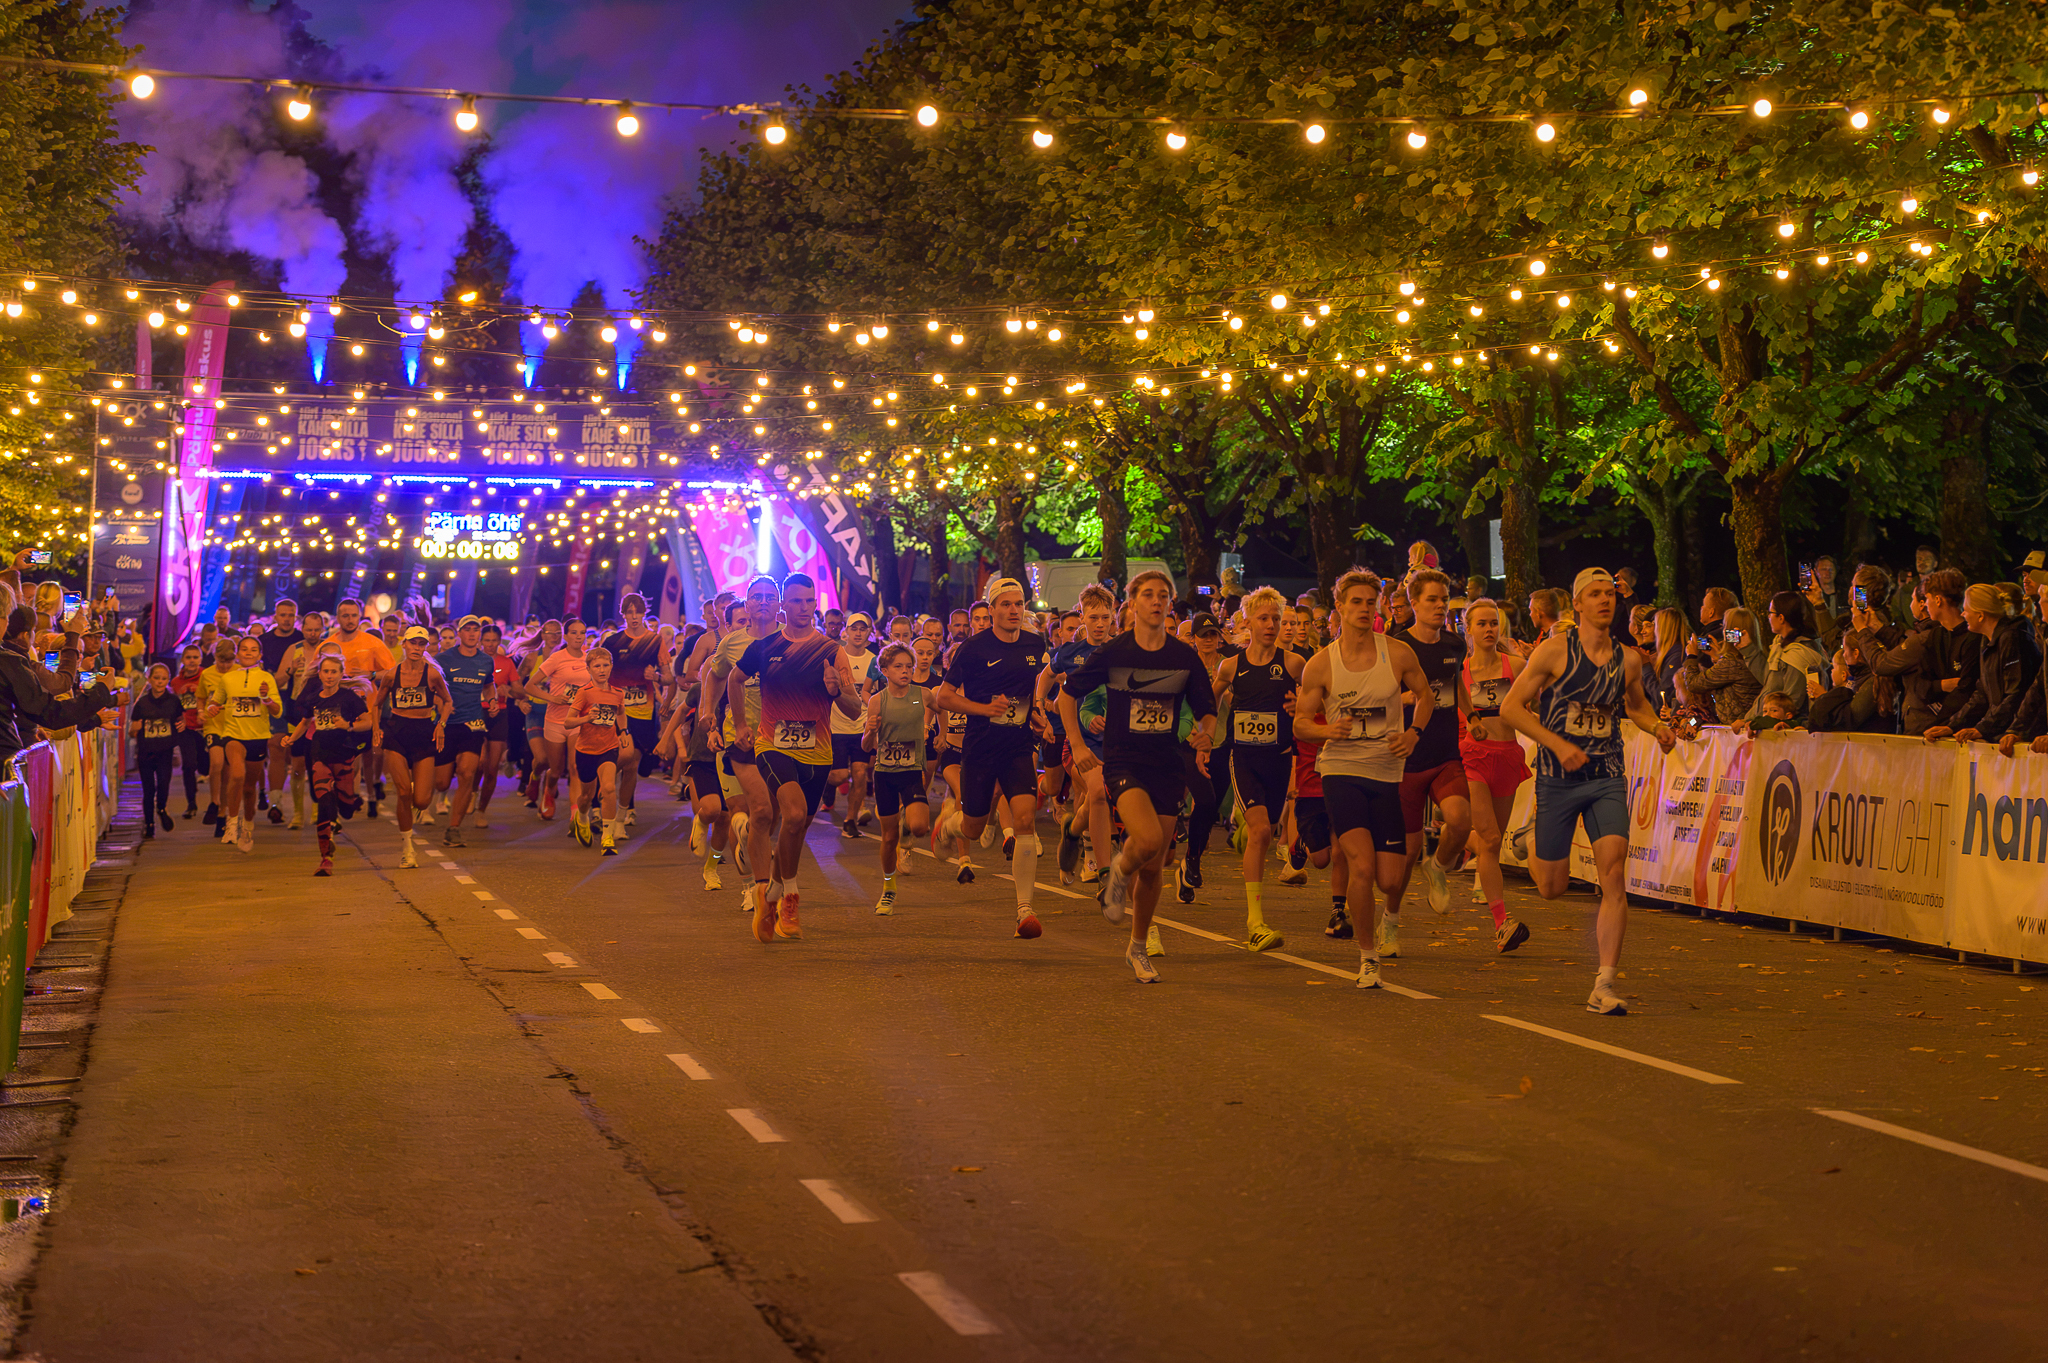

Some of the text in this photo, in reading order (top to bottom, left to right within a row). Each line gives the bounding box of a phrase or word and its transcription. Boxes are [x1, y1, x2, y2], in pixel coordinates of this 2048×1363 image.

[298, 420, 369, 438] KAHE SILLA
[430, 424, 463, 440] SILLA
[487, 425, 557, 442] KAHE SILLA
[581, 427, 651, 444] KAHE SILLA
[421, 540, 519, 560] 00:00:08
[400, 693, 423, 703] 479
[625, 690, 644, 700] 470
[1433, 688, 1441, 701] 2
[1487, 688, 1496, 701] 5
[236, 702, 256, 712] 381
[1007, 705, 1016, 718] 3
[1136, 709, 1169, 724] 236
[1573, 713, 1606, 730] 419
[1238, 721, 1276, 736] 1299
[1359, 718, 1367, 733] 1
[779, 729, 811, 743] 259
[884, 749, 911, 761] 204
[1812, 789, 1949, 879] KROOTLIGHT
